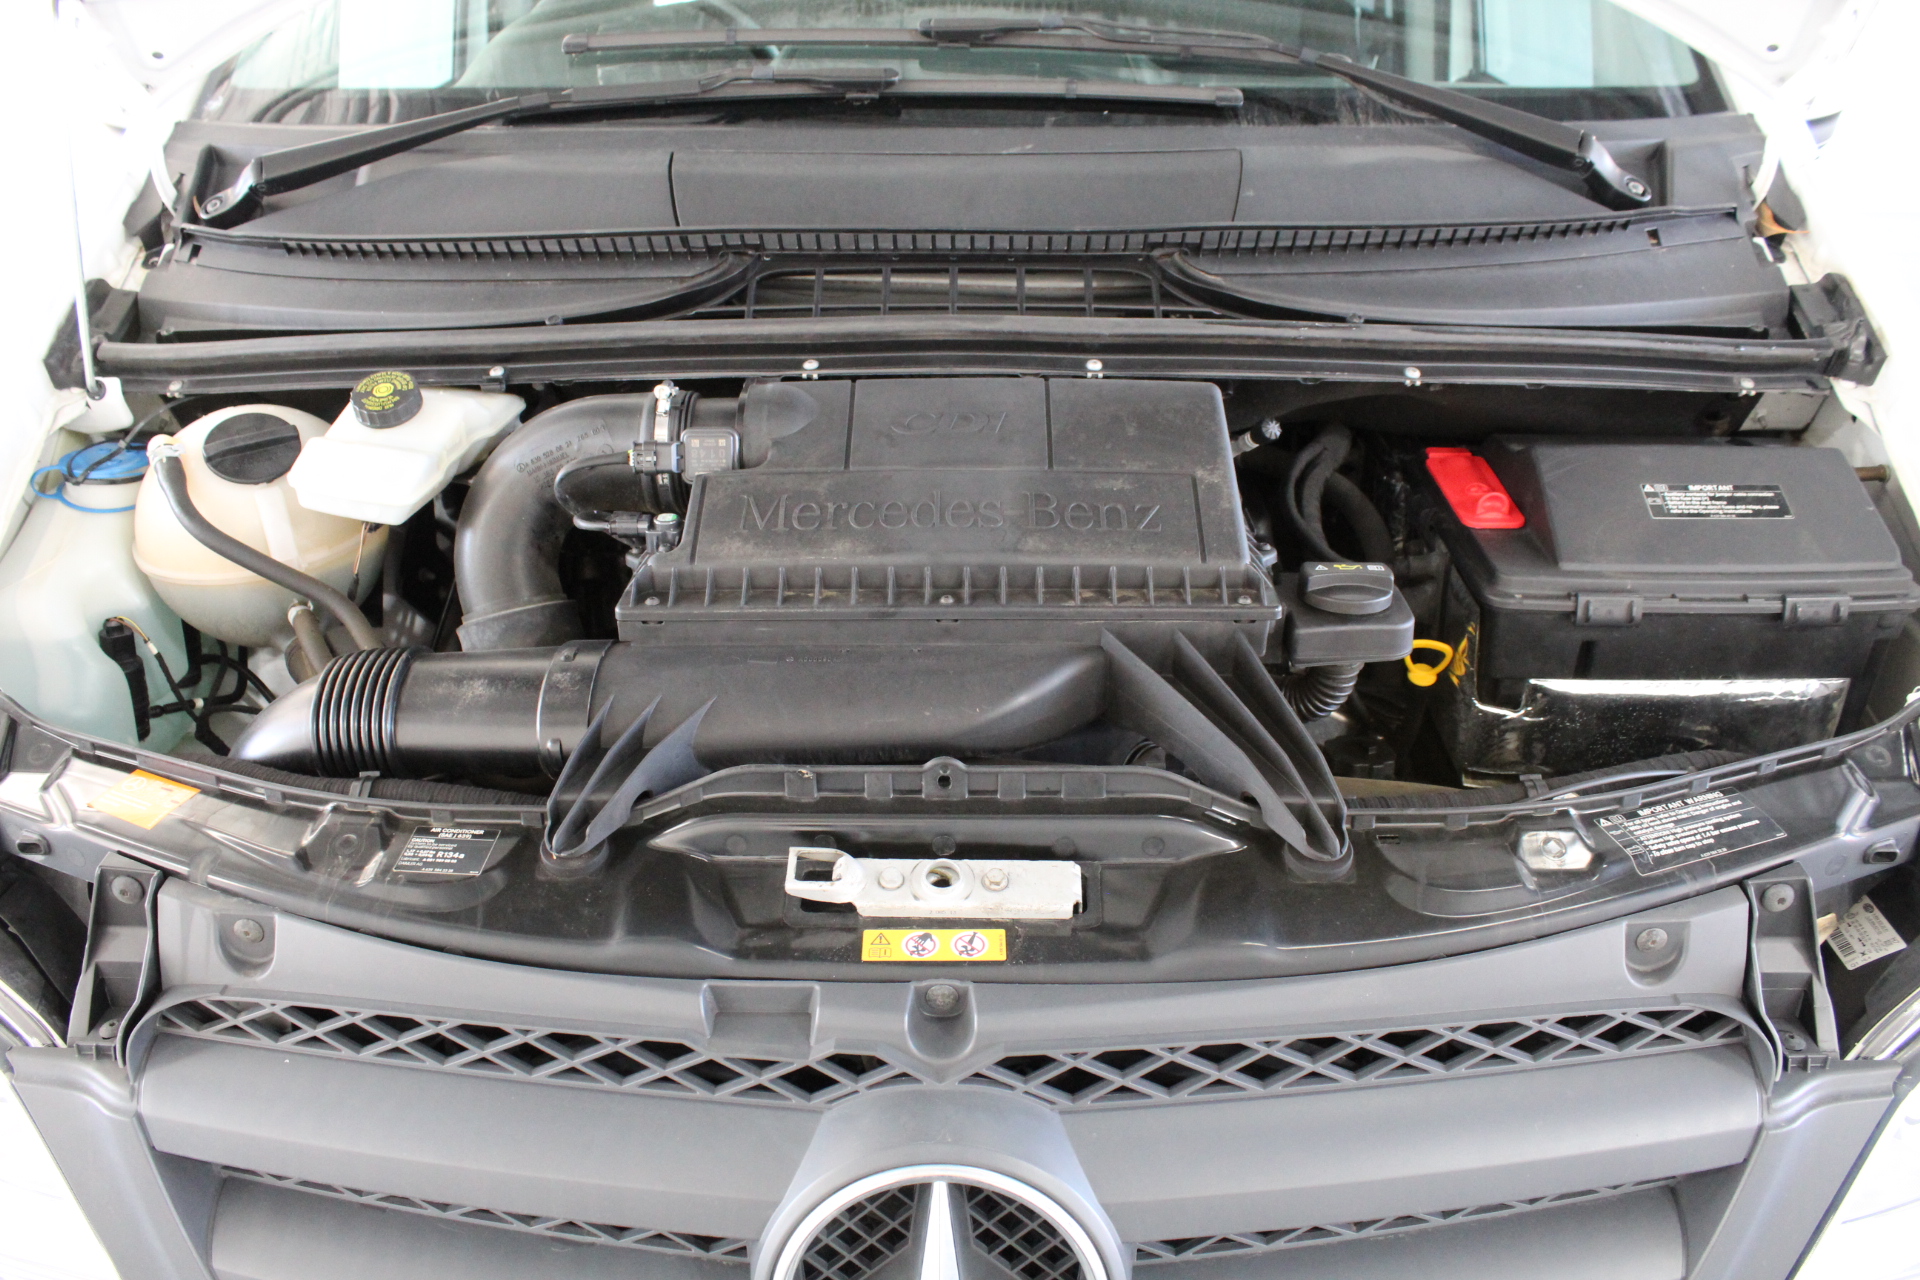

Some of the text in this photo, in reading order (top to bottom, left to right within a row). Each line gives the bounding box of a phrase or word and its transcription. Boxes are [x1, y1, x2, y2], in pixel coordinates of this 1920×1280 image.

[890, 411, 1007, 435] CDI
[1637, 791, 1724, 816] IMPORTANT WARNING
